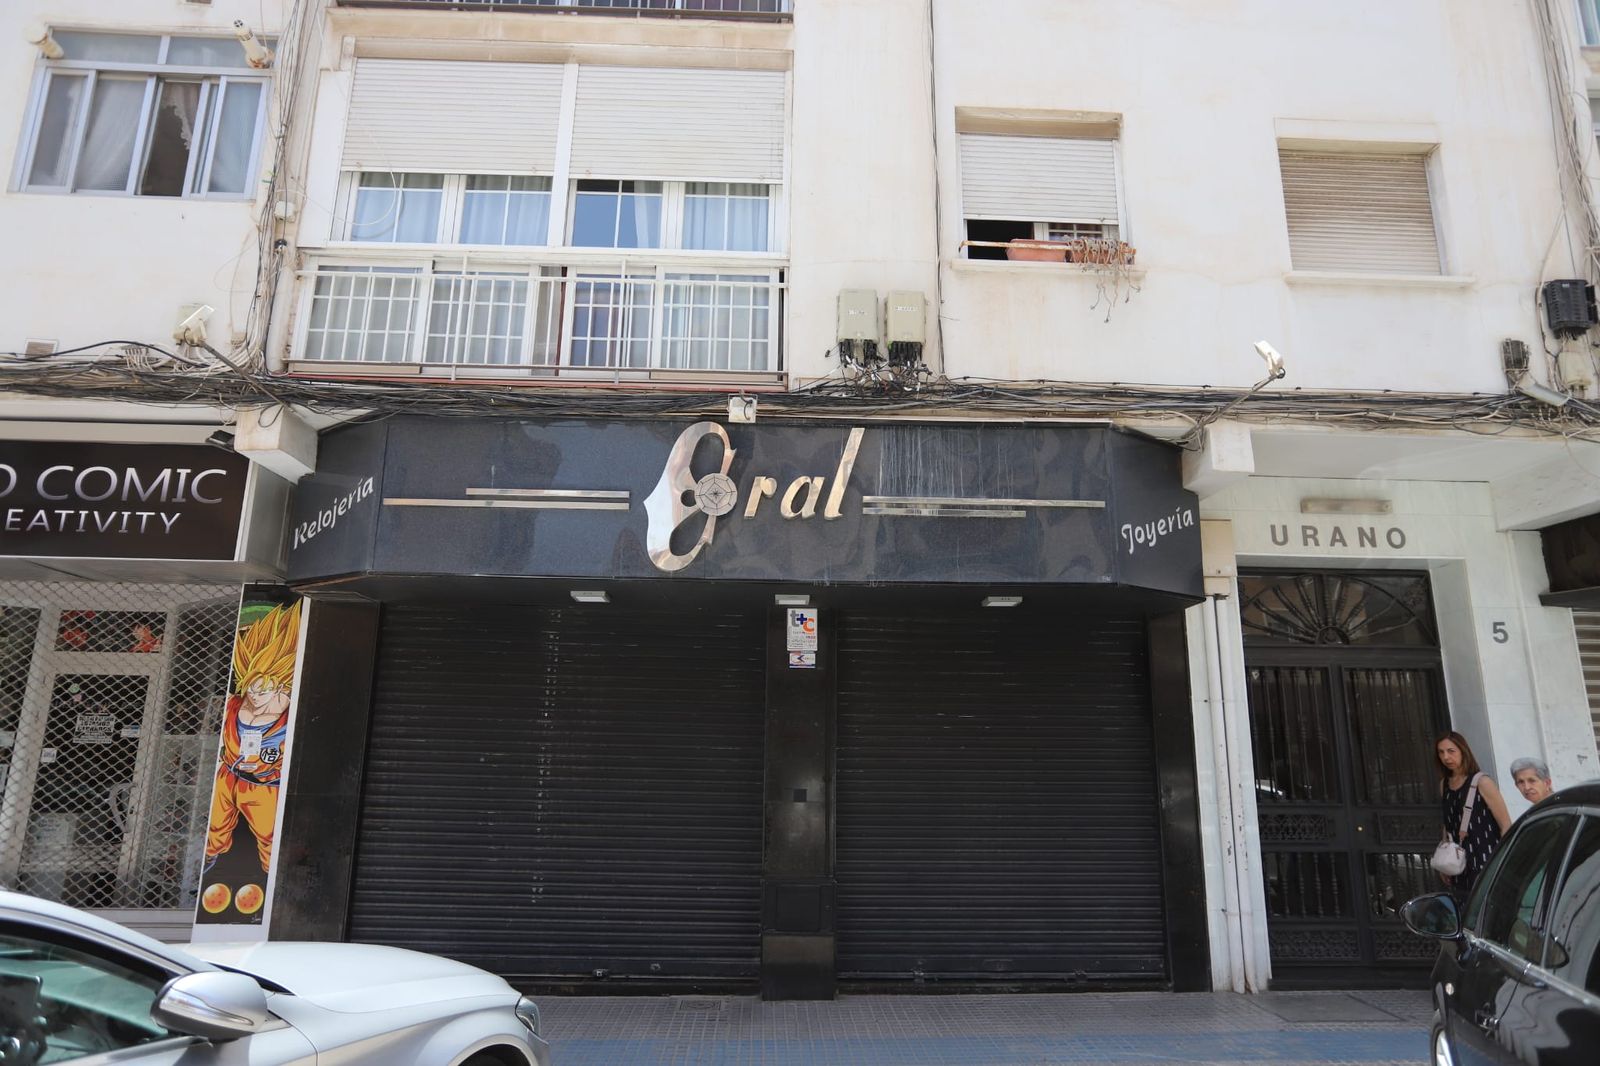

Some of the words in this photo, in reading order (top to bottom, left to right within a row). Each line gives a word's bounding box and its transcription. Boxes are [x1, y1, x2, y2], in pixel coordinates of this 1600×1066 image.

[36, 464, 227, 504] COMIC
[5, 508, 181, 534] EATIVITY
[293, 476, 374, 550] Relojería
[1121, 506, 1194, 555] Joyería
[1270, 524, 1407, 549] URANO
[1492, 621, 1509, 644] 5
